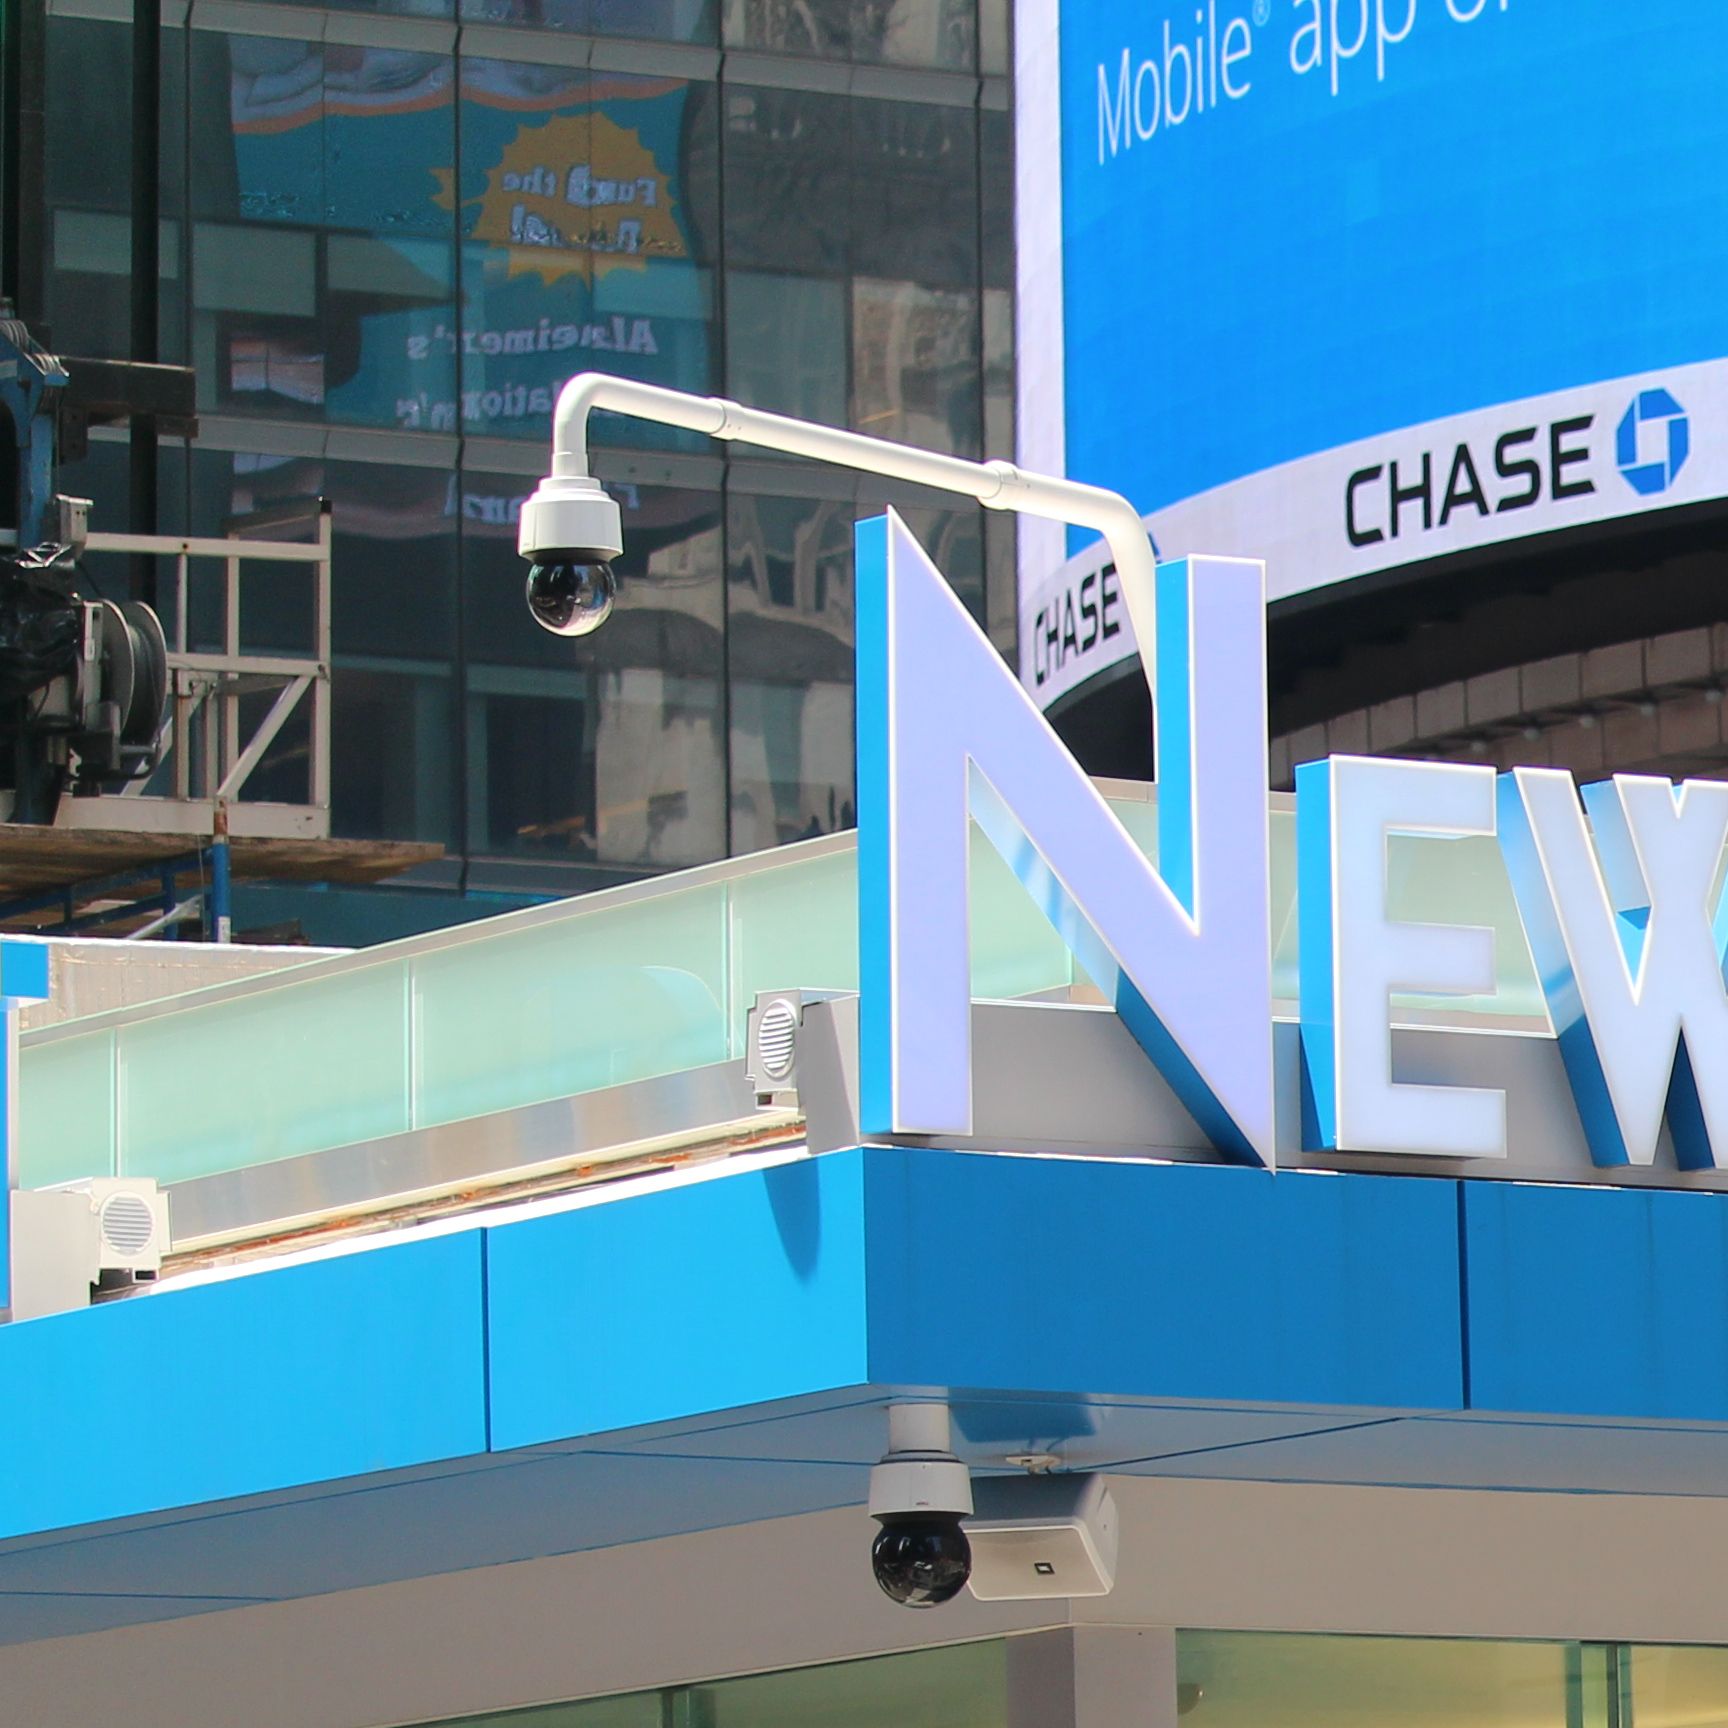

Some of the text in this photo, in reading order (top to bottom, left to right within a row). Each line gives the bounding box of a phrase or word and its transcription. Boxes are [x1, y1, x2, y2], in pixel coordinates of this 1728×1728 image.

[1289, 0, 1417, 97] app
[1345, 412, 1597, 547] CHASE
[1034, 562, 1121, 686] CHASE
